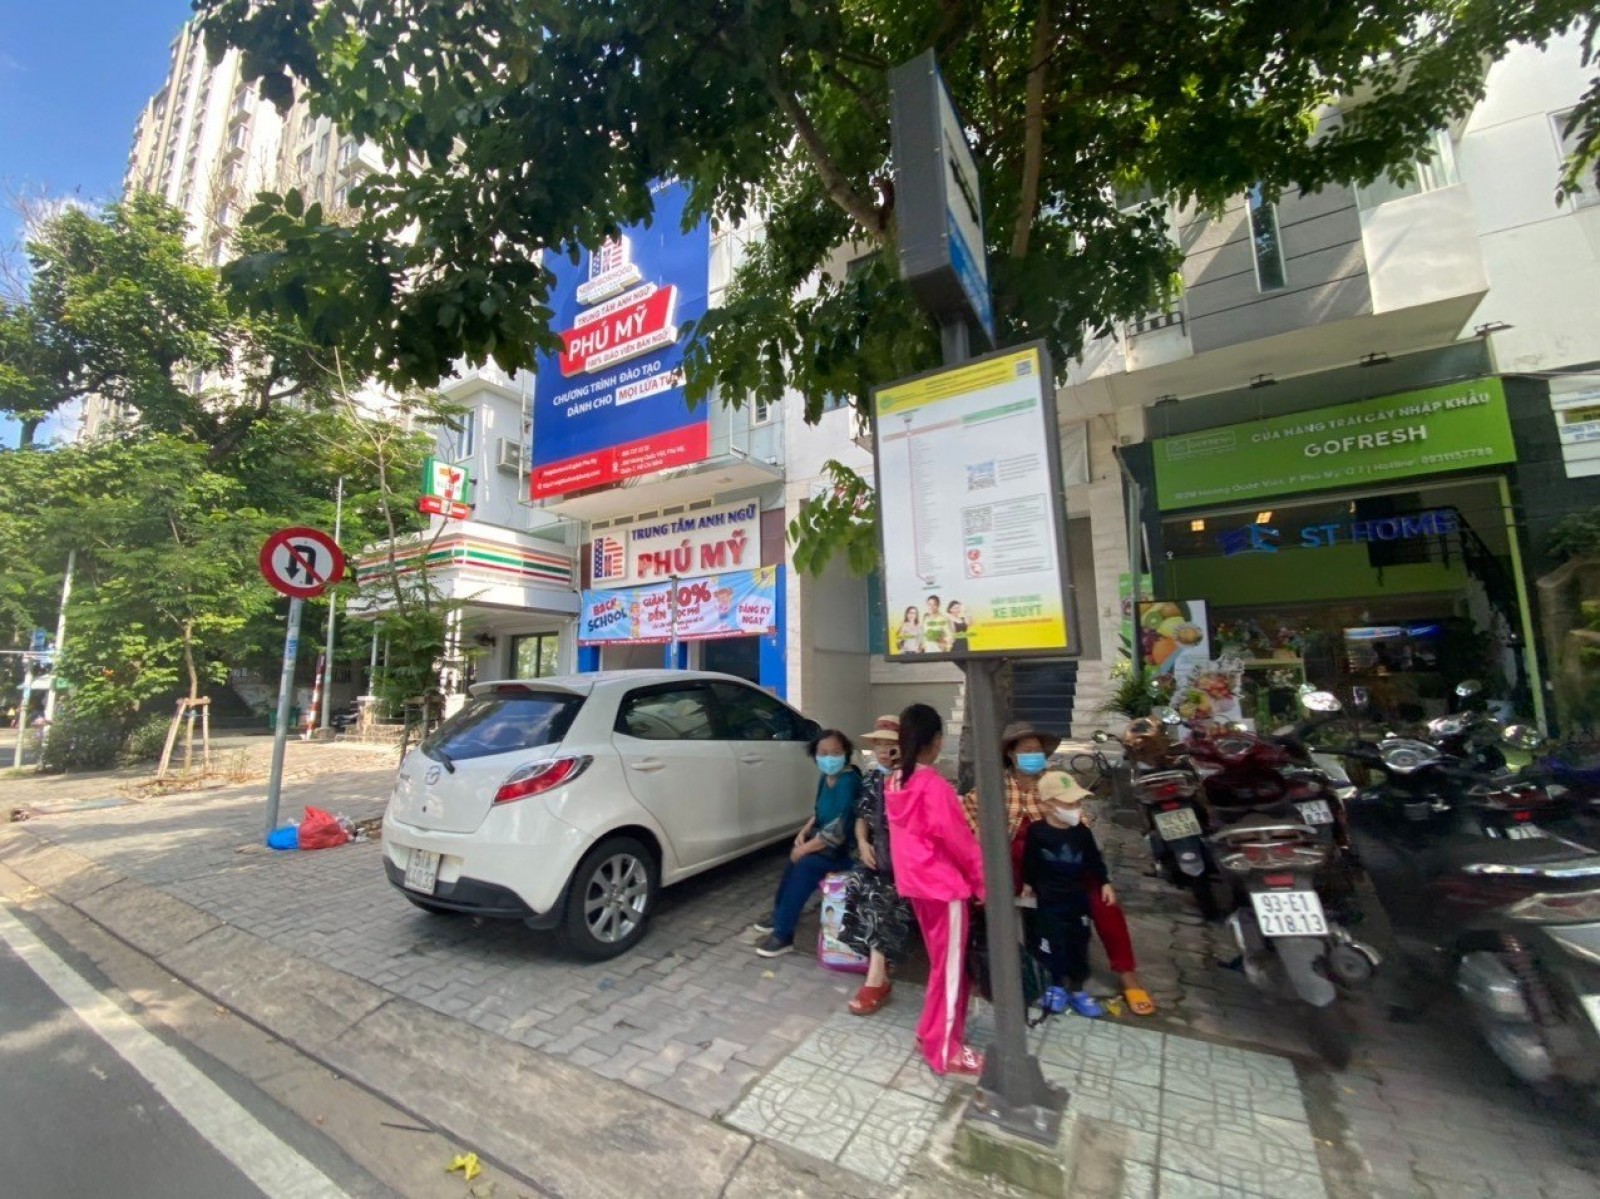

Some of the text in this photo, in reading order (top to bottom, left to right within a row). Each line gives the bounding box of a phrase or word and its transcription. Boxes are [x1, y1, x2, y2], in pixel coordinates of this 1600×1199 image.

[578, 306, 600, 326] TRUNG
[617, 295, 632, 308] ANH
[568, 304, 648, 362] PHÚ MỸ
[552, 360, 662, 406] CHƯƠNG TRÌNH ĐÀO TẠO
[567, 402, 592, 418] DÀNH
[593, 395, 613, 409] CHO
[618, 385, 638, 401] MỌI
[1399, 400, 1443, 416] NHẬP
[1445, 389, 1490, 409] KHẨU
[1304, 424, 1428, 457] GOFRESH
[631, 503, 757, 542] TRUNG TÂM ANH NGỮ
[1300, 510, 1459, 548] ST HOME
[637, 529, 748, 579] PHÚ MỸ
[587, 607, 628, 633] SCHOOL
[742, 615, 765, 625] NGAY
[1261, 893, 1310, 913] 93-E1
